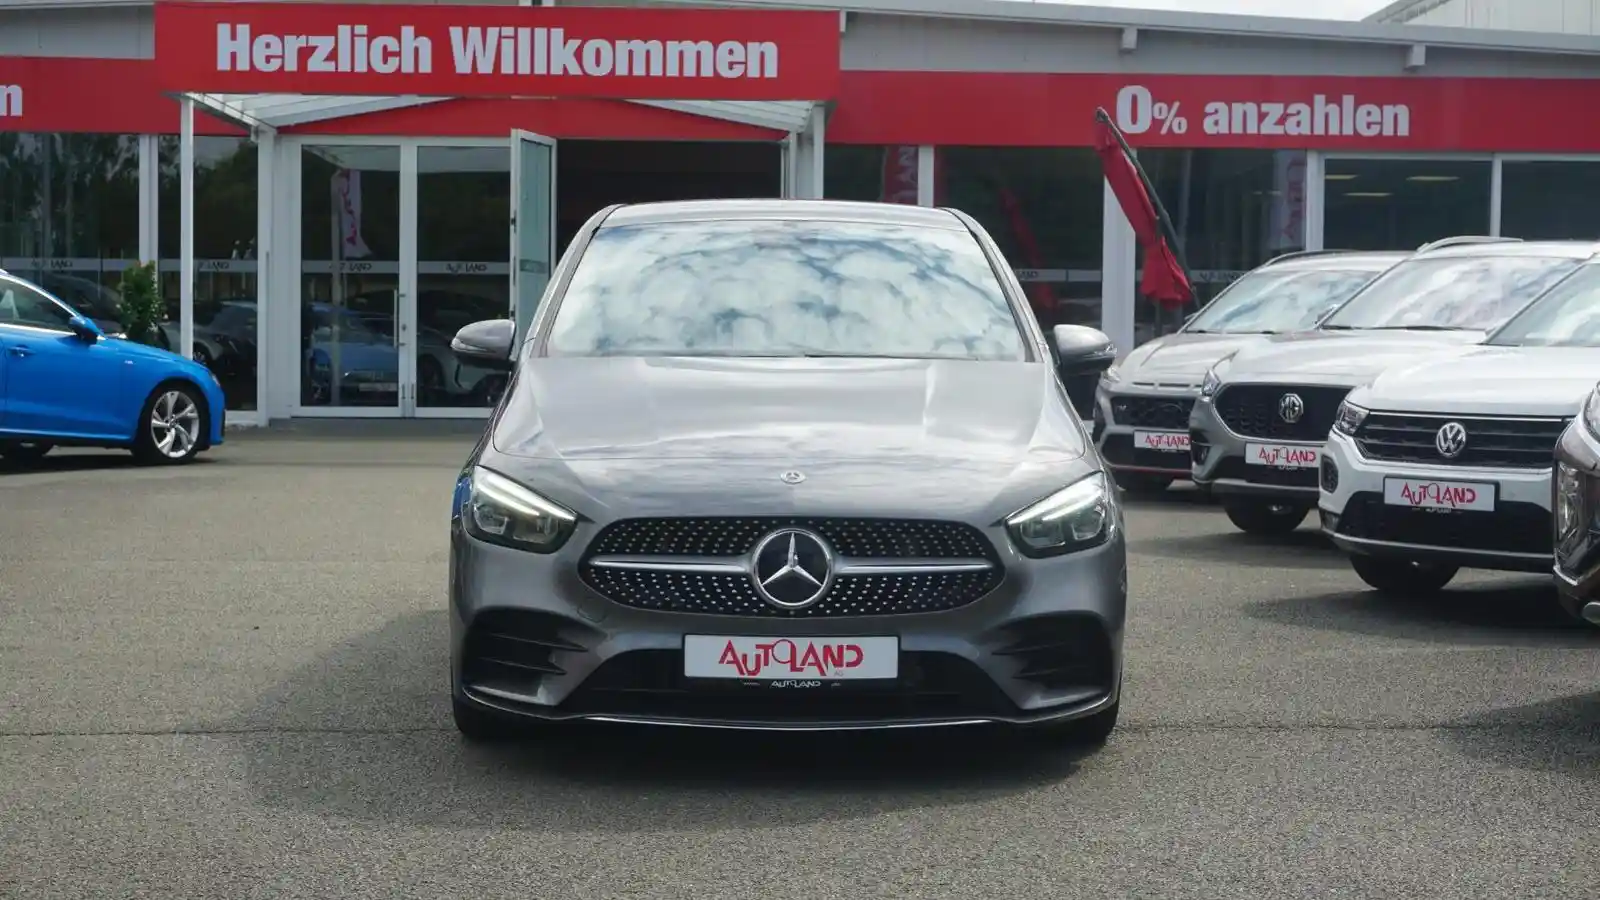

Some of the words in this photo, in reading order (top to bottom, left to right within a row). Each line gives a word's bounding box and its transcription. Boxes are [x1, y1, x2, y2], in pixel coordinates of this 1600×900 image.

[217, 23, 432, 74] Herzlich
[449, 26, 778, 79] Willkommen
[1116, 85, 1187, 134] 0%
[1203, 94, 1410, 137] anzahlen
[1400, 482, 1477, 508] AUTOLAND
[719, 638, 864, 677] AUTOLAND
[771, 679, 822, 688] AUTOLAND
